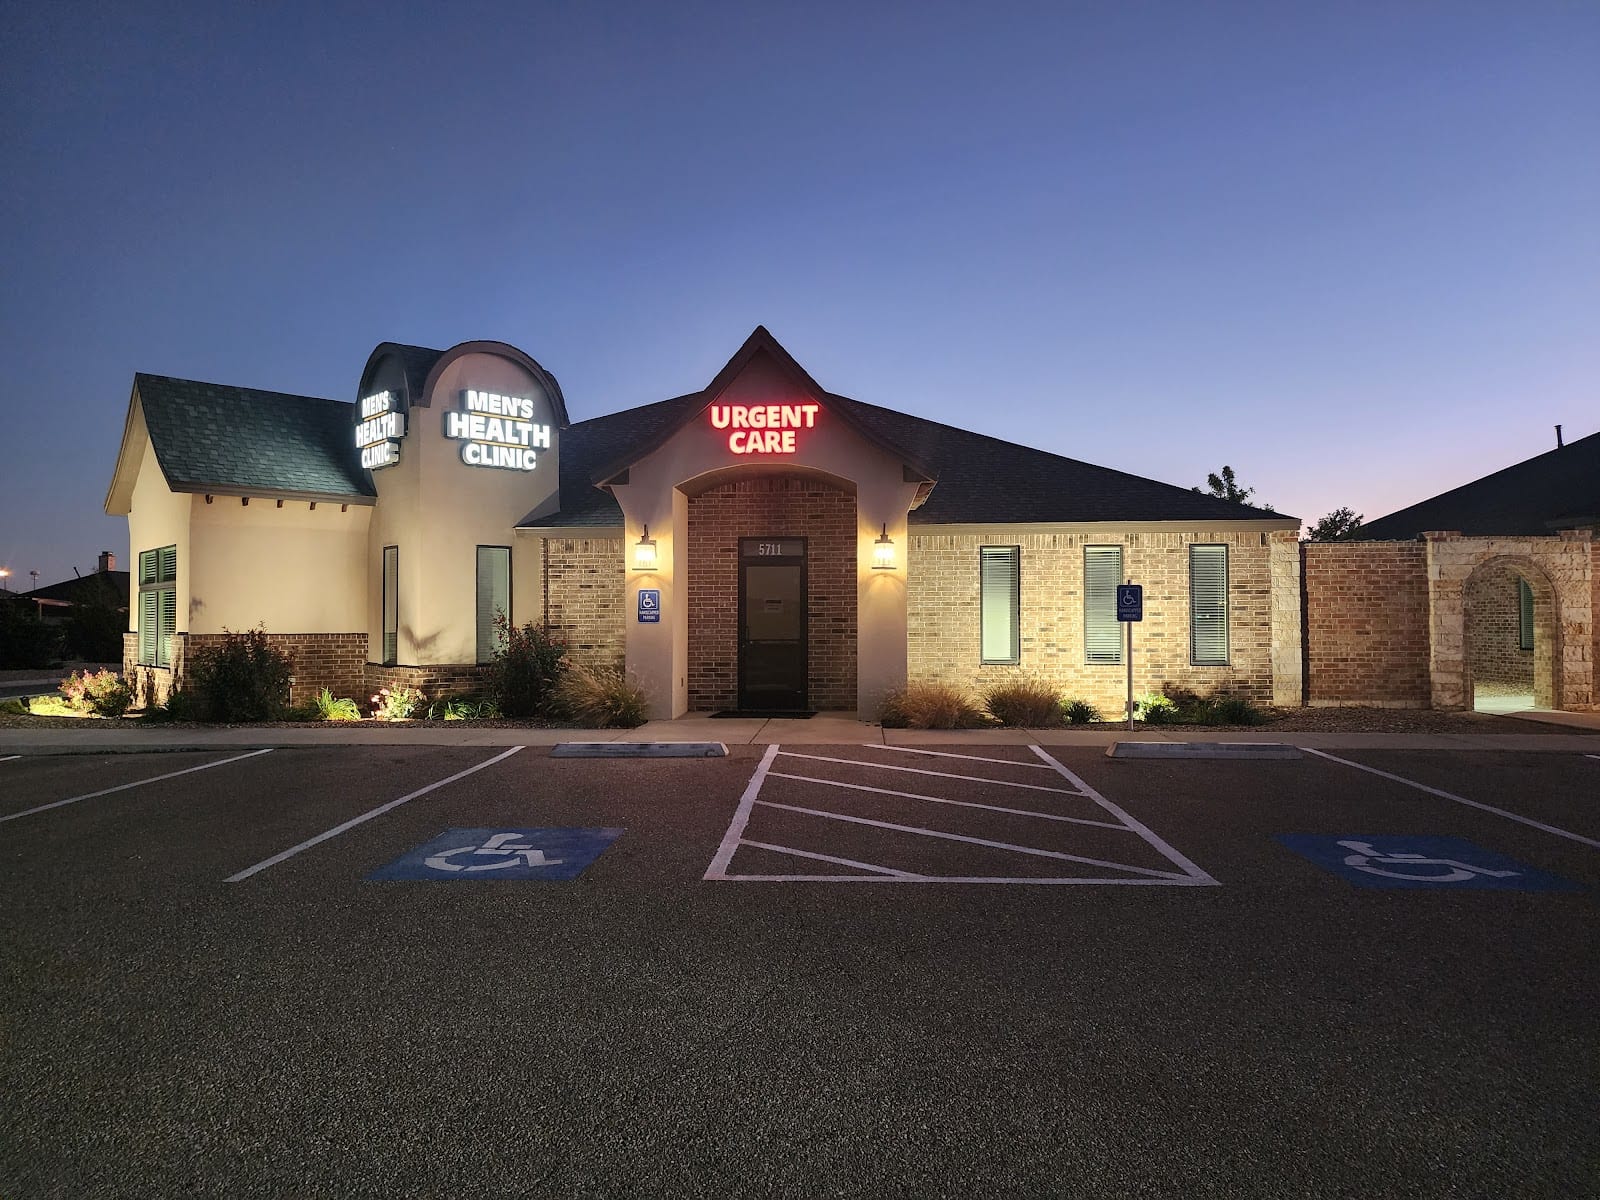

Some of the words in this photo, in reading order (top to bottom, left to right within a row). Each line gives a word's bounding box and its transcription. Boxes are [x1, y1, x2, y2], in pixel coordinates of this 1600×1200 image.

[466, 390, 534, 419] MEN'S
[711, 405, 819, 429] URGENT
[355, 411, 396, 448] HEALTH
[447, 412, 551, 448] HEALTH
[729, 430, 796, 454] CARE
[361, 441, 391, 469] CLINIC
[463, 443, 537, 470] CLINIC
[758, 543, 782, 556] 5711
